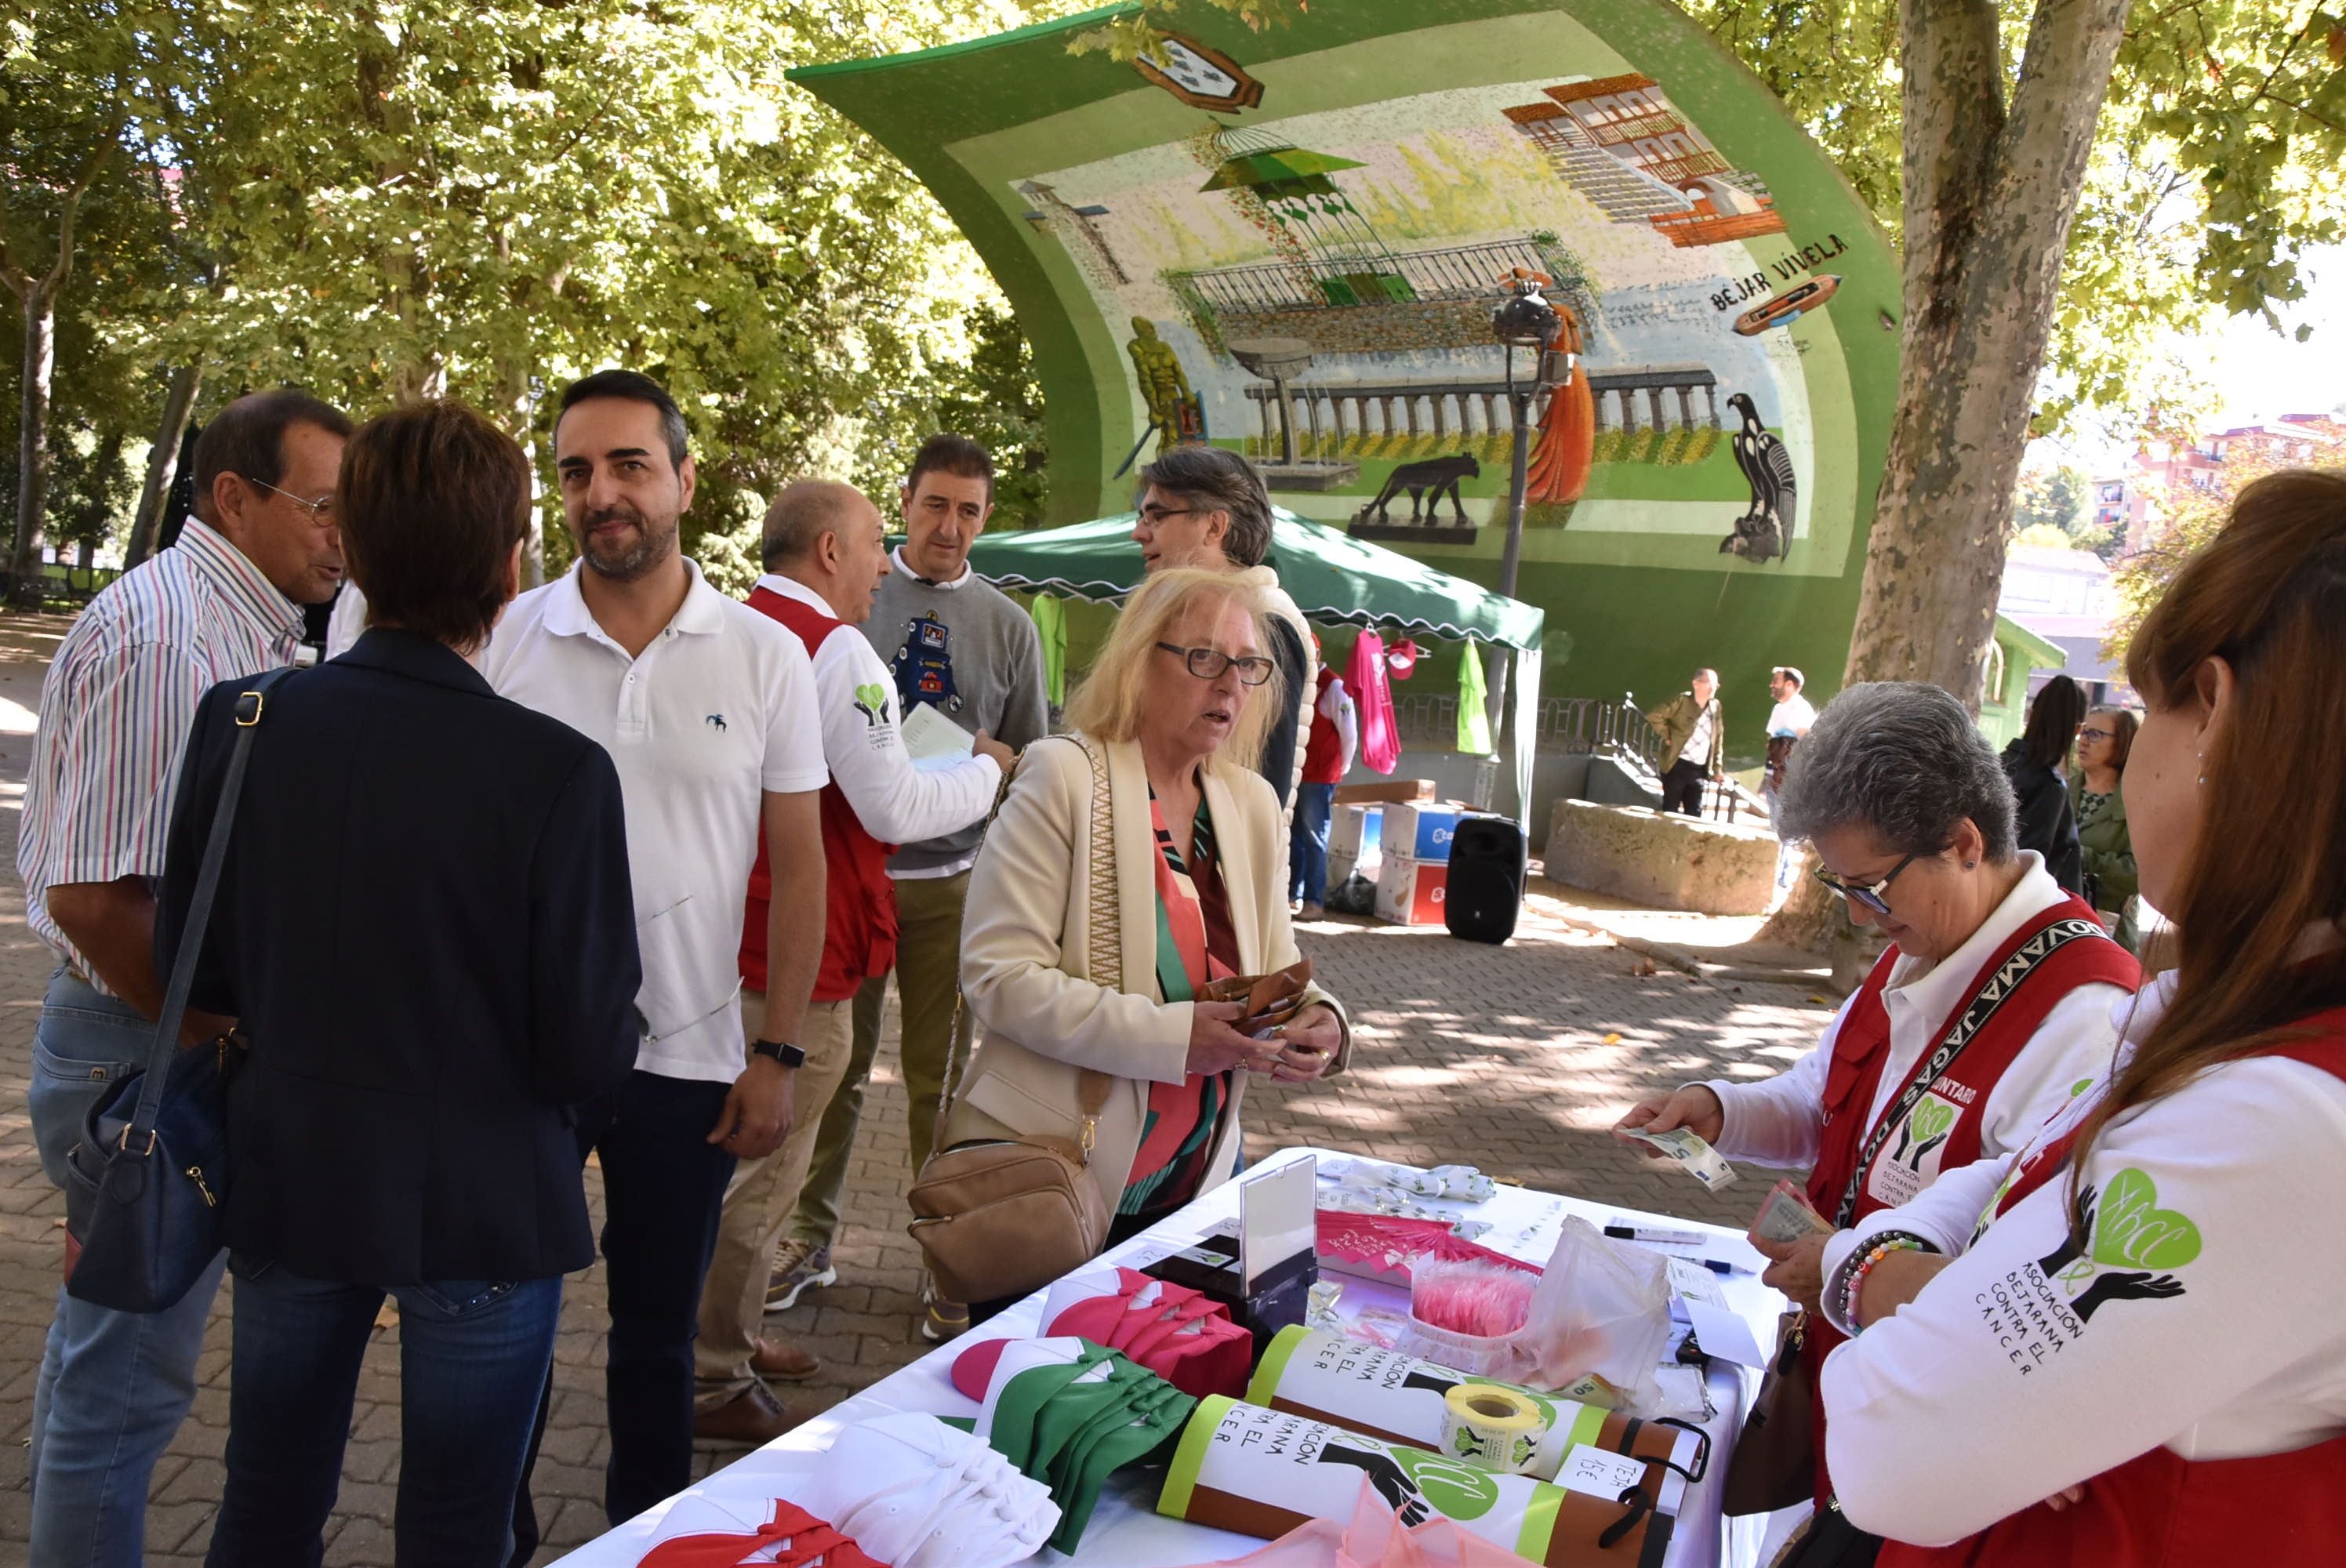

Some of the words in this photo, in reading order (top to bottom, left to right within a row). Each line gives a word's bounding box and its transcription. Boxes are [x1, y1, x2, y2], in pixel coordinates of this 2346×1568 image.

[1903, 1011, 1977, 1106] JAGAS
[1991, 1283, 2028, 1339] CONTRA
[2028, 1341, 2046, 1365] EL
[2006, 1272, 2064, 1353] BEJARANA
[2022, 1261, 2083, 1339] ASOCIACIÓN
[1335, 1359, 1356, 1374] EL
[1574, 1383, 1594, 1395] 50
[1240, 1429, 1263, 1447] EL
